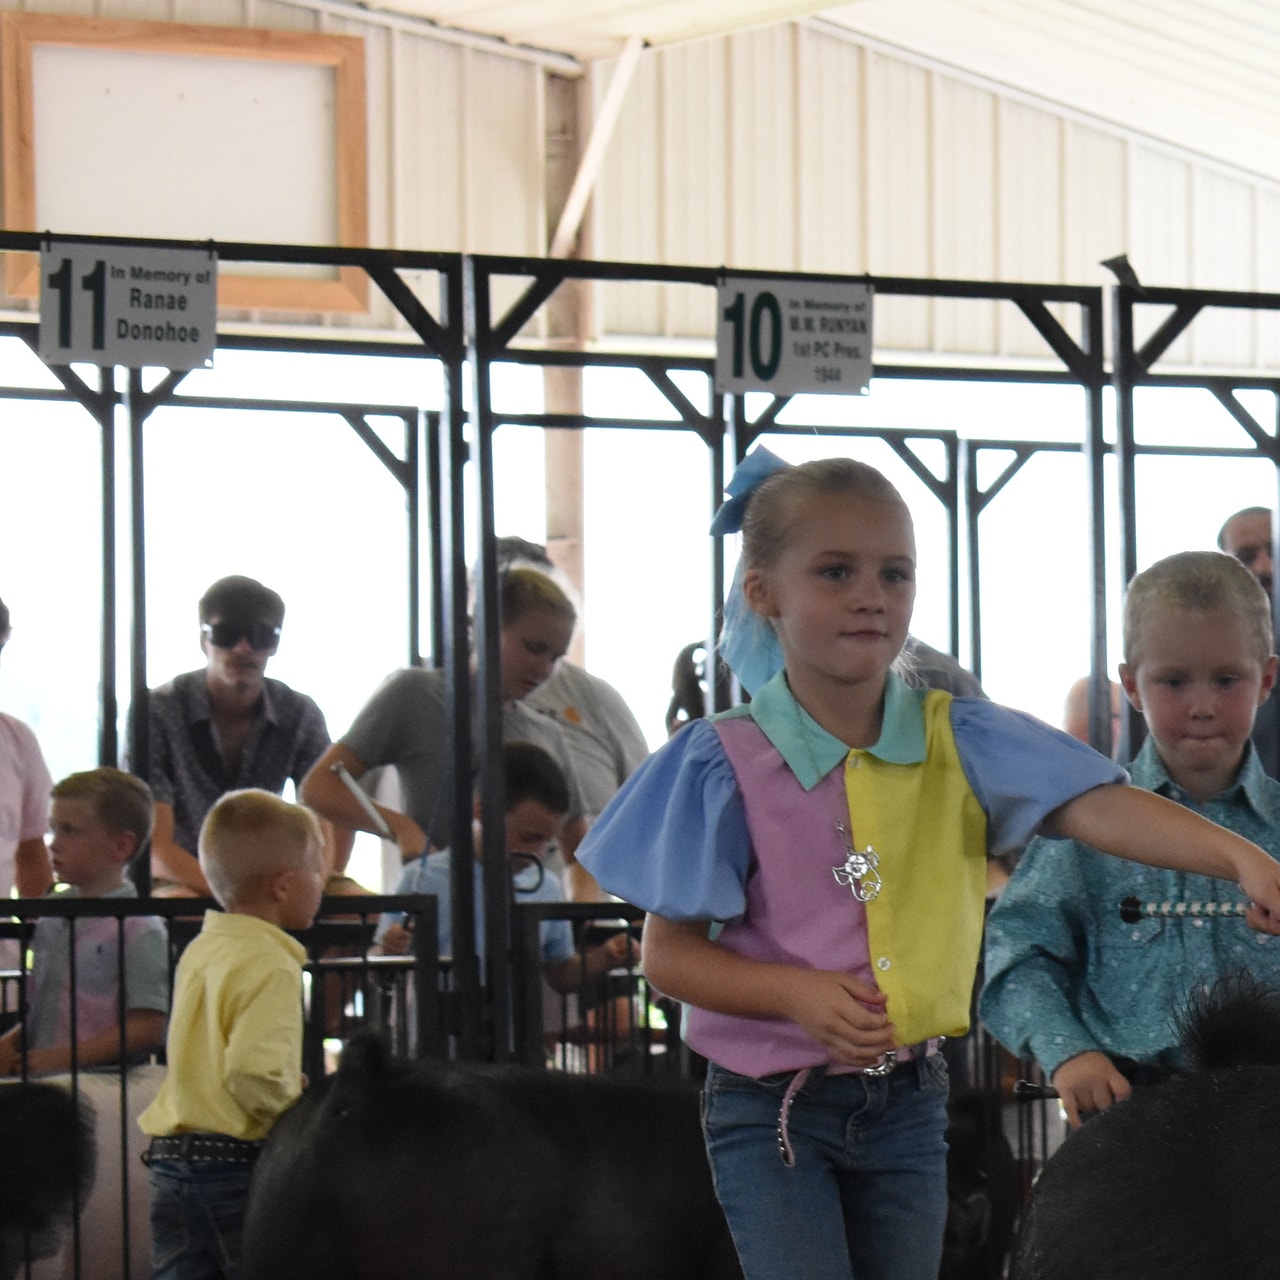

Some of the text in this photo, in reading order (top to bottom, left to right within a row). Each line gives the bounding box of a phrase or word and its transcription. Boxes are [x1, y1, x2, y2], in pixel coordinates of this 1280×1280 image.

[111, 266, 211, 286] In Memory of
[48, 258, 106, 350] 11
[130, 288, 188, 310] Ranae
[804, 300, 849, 313] Memory
[117, 318, 199, 343] Donohoe
[723, 291, 783, 382] 10
